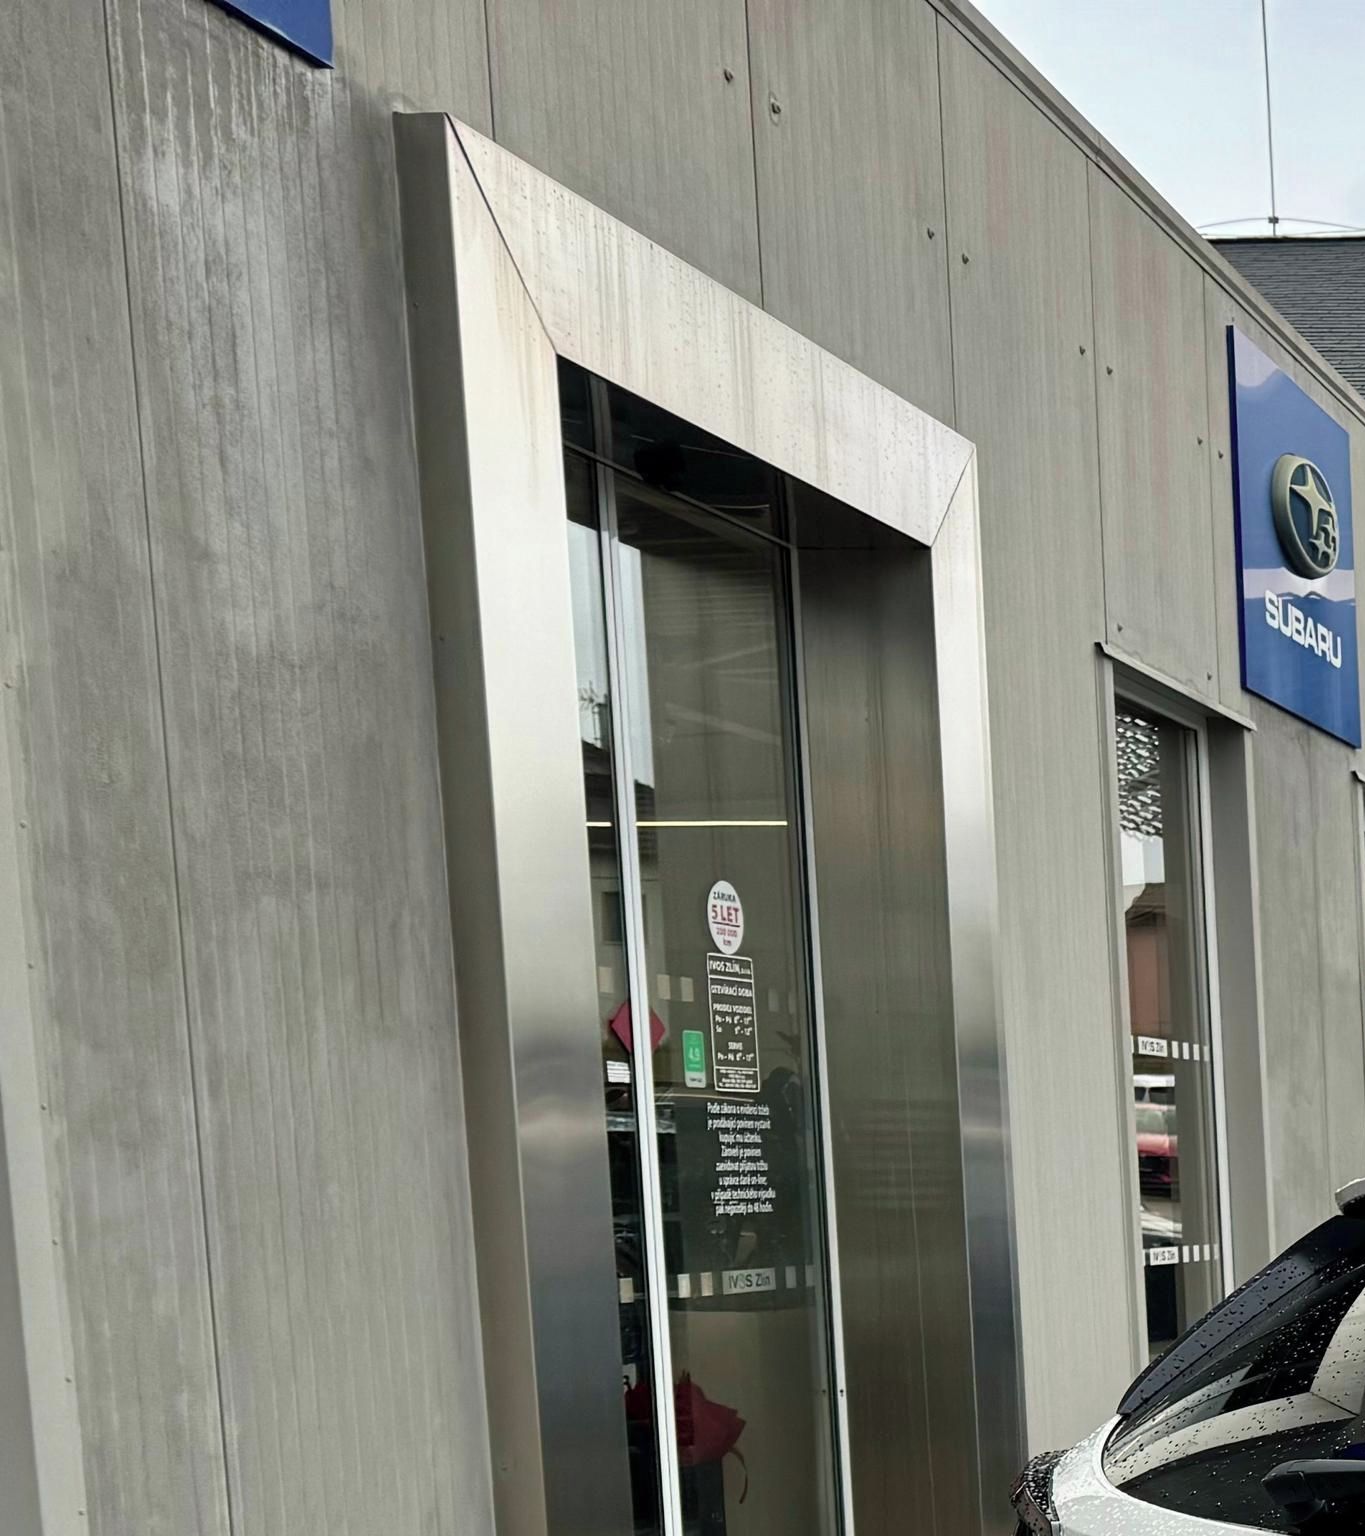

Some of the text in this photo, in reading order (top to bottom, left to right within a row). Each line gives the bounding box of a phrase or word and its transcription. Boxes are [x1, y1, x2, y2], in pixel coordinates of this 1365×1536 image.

[1265, 589, 1342, 669] SUBARU
[711, 904, 740, 924] 5 LET
